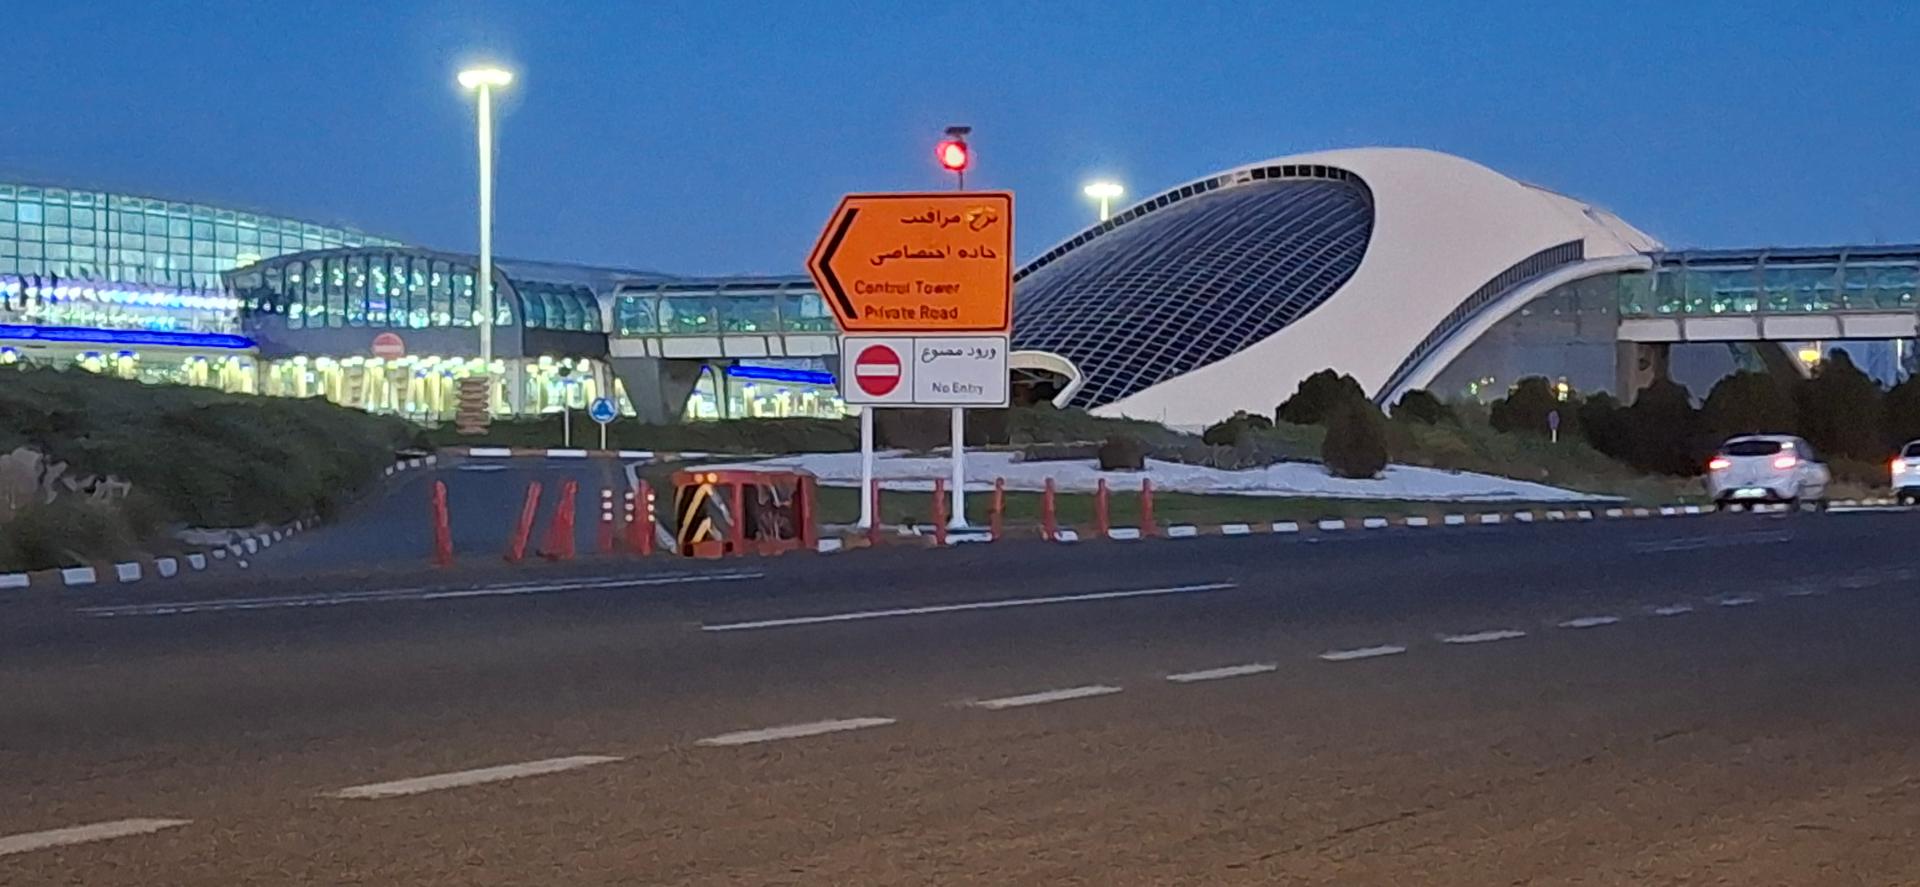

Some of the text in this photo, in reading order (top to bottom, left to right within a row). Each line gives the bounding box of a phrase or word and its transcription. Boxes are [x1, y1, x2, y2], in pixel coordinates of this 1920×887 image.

[854, 280, 961, 295] Control Tower
[864, 305, 958, 320] Private Road
[967, 346, 997, 361] ورود
[932, 382, 984, 396] No Entry
